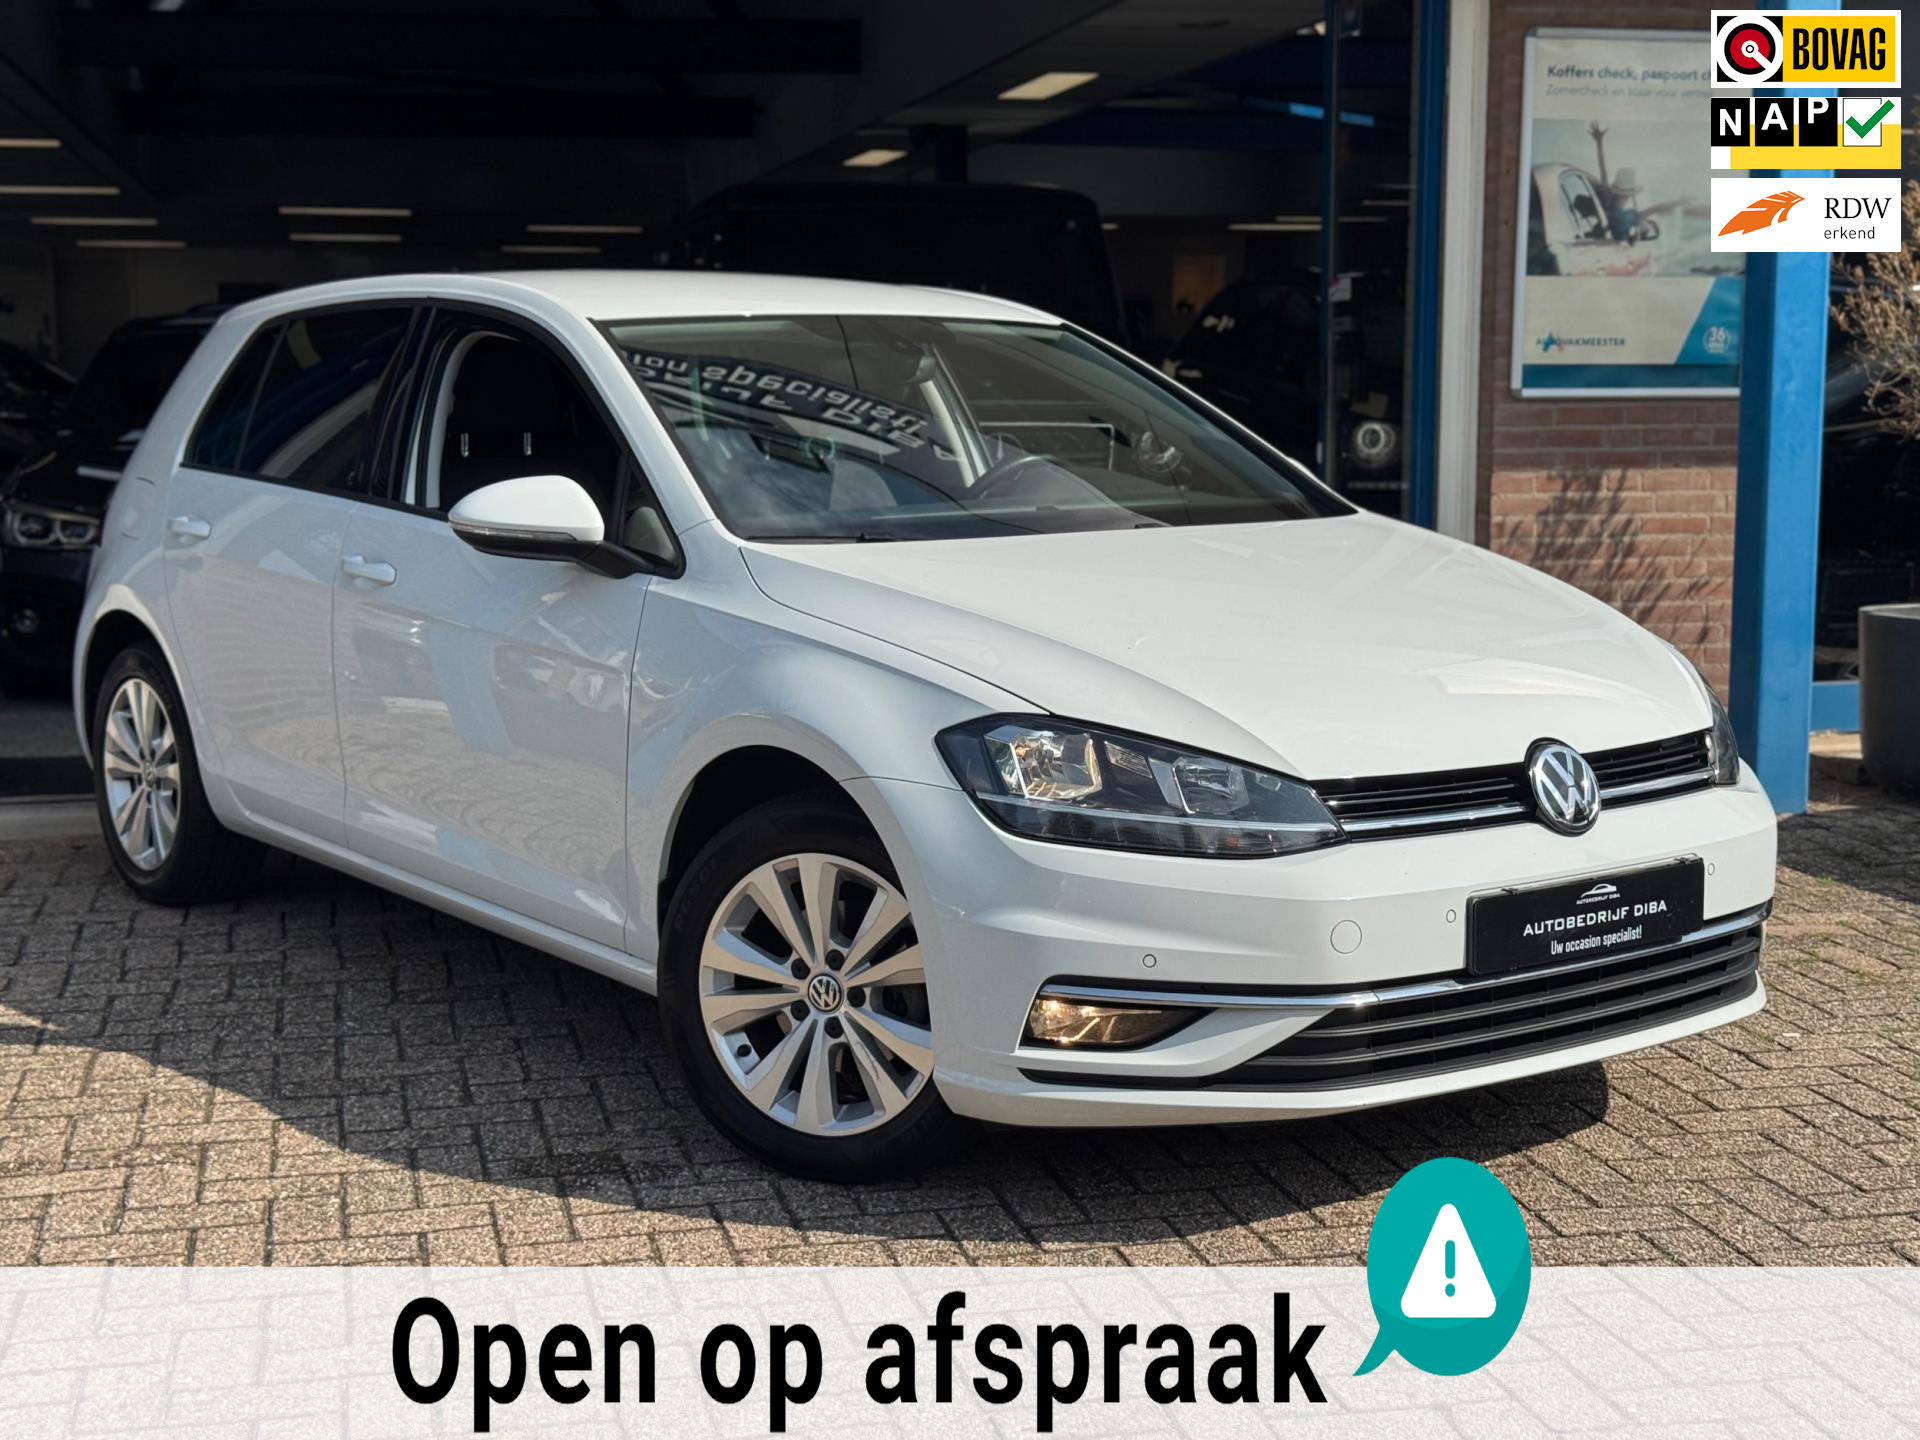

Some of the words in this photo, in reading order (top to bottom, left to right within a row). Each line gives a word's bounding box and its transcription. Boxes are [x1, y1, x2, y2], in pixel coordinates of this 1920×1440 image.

[1548, 65, 1593, 78] Koffers
[1641, 68, 1697, 82] paspoort
[1523, 906, 1630, 937] AUTOBEDRIJF
[1633, 900, 1667, 917] DIBA
[1550, 940, 1564, 955] Uw
[1565, 935, 1601, 953] occasion
[1604, 925, 1642, 946] specialist!
